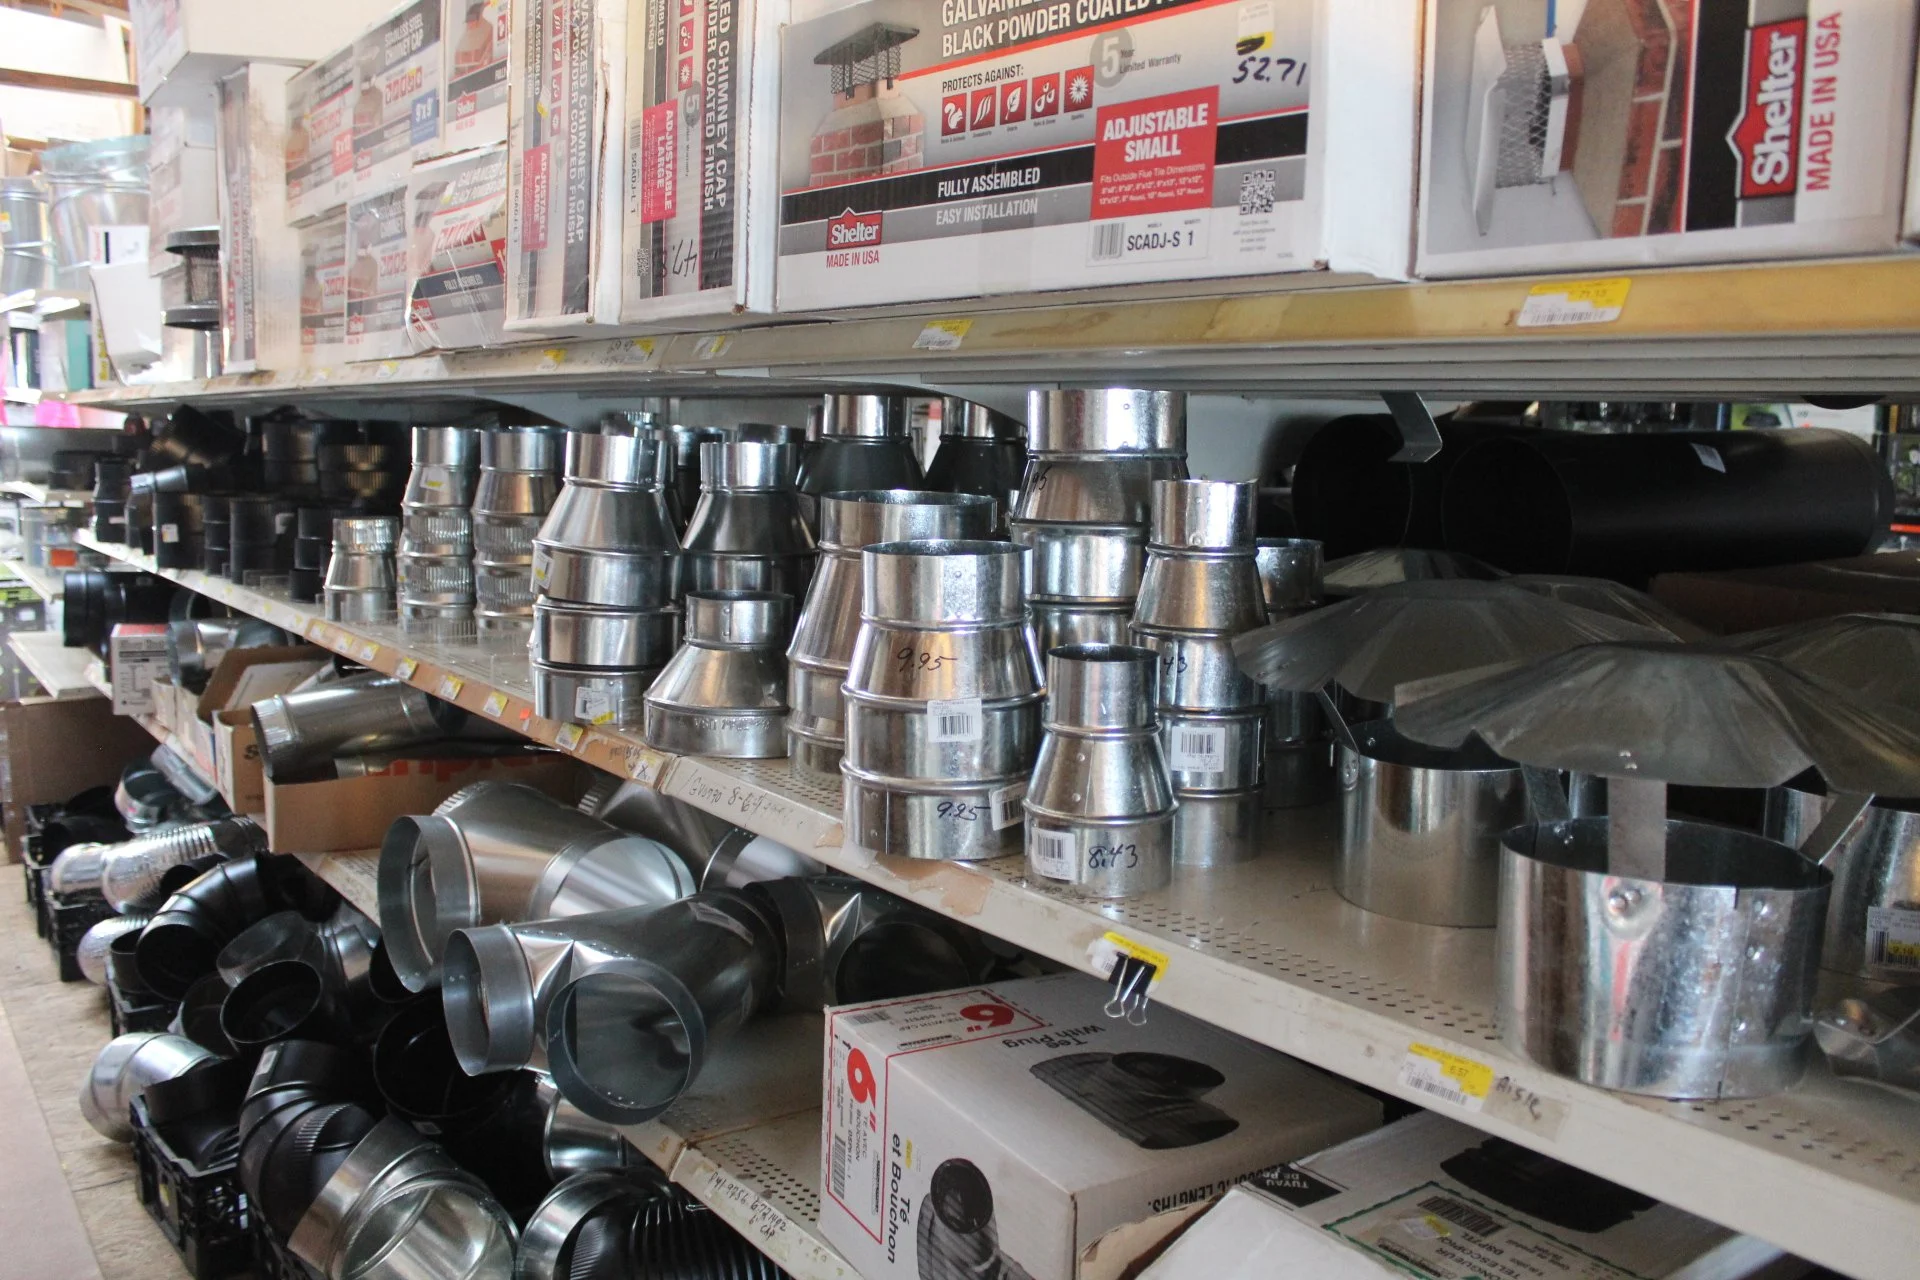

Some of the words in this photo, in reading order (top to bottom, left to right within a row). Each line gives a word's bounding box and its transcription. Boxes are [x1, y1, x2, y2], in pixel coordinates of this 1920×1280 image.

[942, 22, 994, 58] BLACK
[998, 0, 1071, 45] POWDER
[1813, 11, 1842, 70] USA
[1100, 36, 1119, 79] 5
[1148, 52, 1183, 68] Warranty
[1232, 56, 1308, 87] 52.71
[705, 58, 716, 138] COATED
[717, 41, 730, 151] CHIMNEY
[942, 73, 983, 94] PROTECTS
[985, 64, 1024, 84] AGAINST:
[1811, 76, 1837, 106] IN
[1103, 103, 1209, 141] ADJUSTABLE
[1752, 31, 1797, 185] Shelter
[568, 110, 578, 178] COATED
[577, 95, 588, 190] CHIMNEY
[656, 135, 666, 189] LARGE
[664, 109, 674, 211] ADJUSTABLE
[1124, 134, 1182, 163] SMALL
[1805, 113, 1832, 192] MADE
[538, 152, 548, 242] ADJUSTABLE
[703, 144, 715, 211] FINISH
[715, 159, 727, 208] CAP
[938, 179, 968, 198] FULLY
[971, 167, 1041, 193] ASSEMBLED
[533, 175, 541, 222] LARGE
[566, 185, 577, 244] FINISH
[936, 209, 962, 226] EASY
[964, 198, 1038, 223] INSTALLATION
[575, 199, 586, 242] CAP
[831, 223, 879, 245] Shelter
[1127, 231, 1181, 251] SCADJ-S
[1188, 230, 1195, 247] 1
[826, 253, 850, 269] MADE
[851, 251, 860, 266] IN
[862, 250, 880, 265] USA
[1088, 843, 1139, 869] 8.43
[1002, 1034, 1051, 1049] Plug
[1046, 1036, 1089, 1050] Tee
[1052, 1022, 1107, 1039] With
[891, 1133, 902, 1157] et
[1266, 1179, 1309, 1189] TUYAU
[886, 1165, 904, 1264] Bouchon
[898, 1198, 911, 1227] Té
